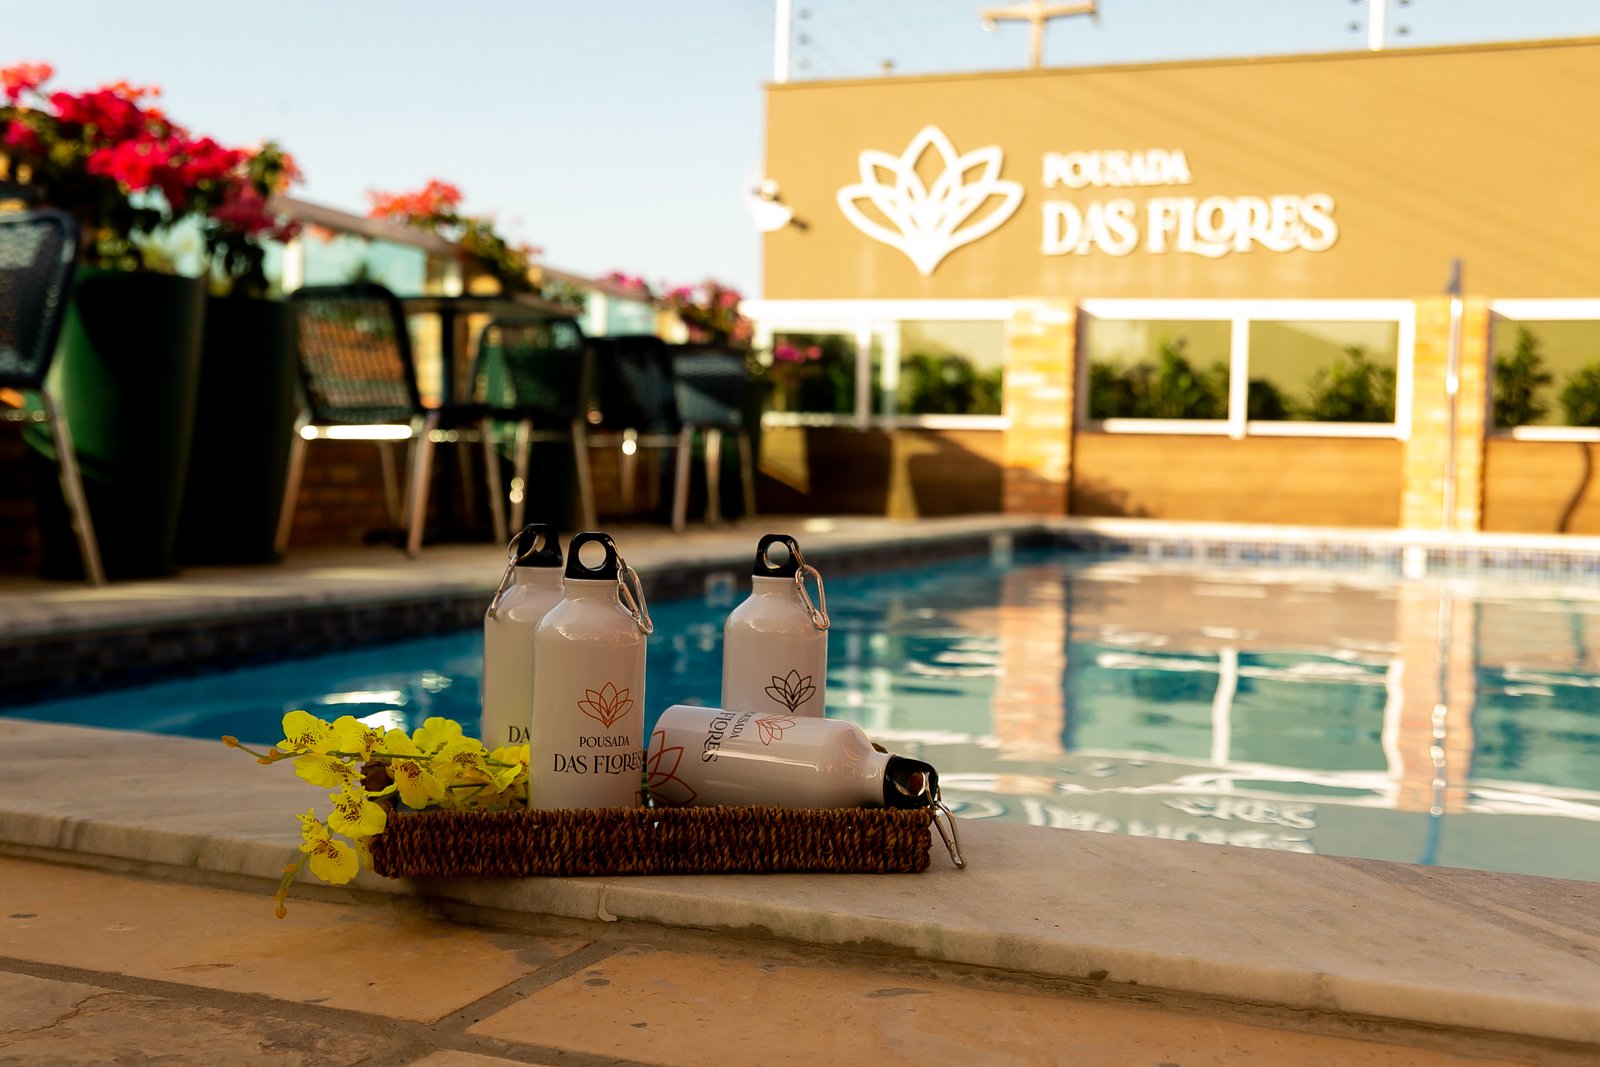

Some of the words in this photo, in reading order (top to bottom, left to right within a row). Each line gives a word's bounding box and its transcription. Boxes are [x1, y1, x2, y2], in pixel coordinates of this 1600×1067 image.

[1042, 148, 1192, 188] POUSADA
[1041, 198, 1138, 256] DAS
[1146, 193, 1338, 258] FLORES
[508, 725, 530, 744] DA
[579, 735, 631, 748] POUSADA
[701, 712, 736, 762] FLORES
[553, 753, 588, 774] DAS
[593, 750, 642, 775] FLORES
